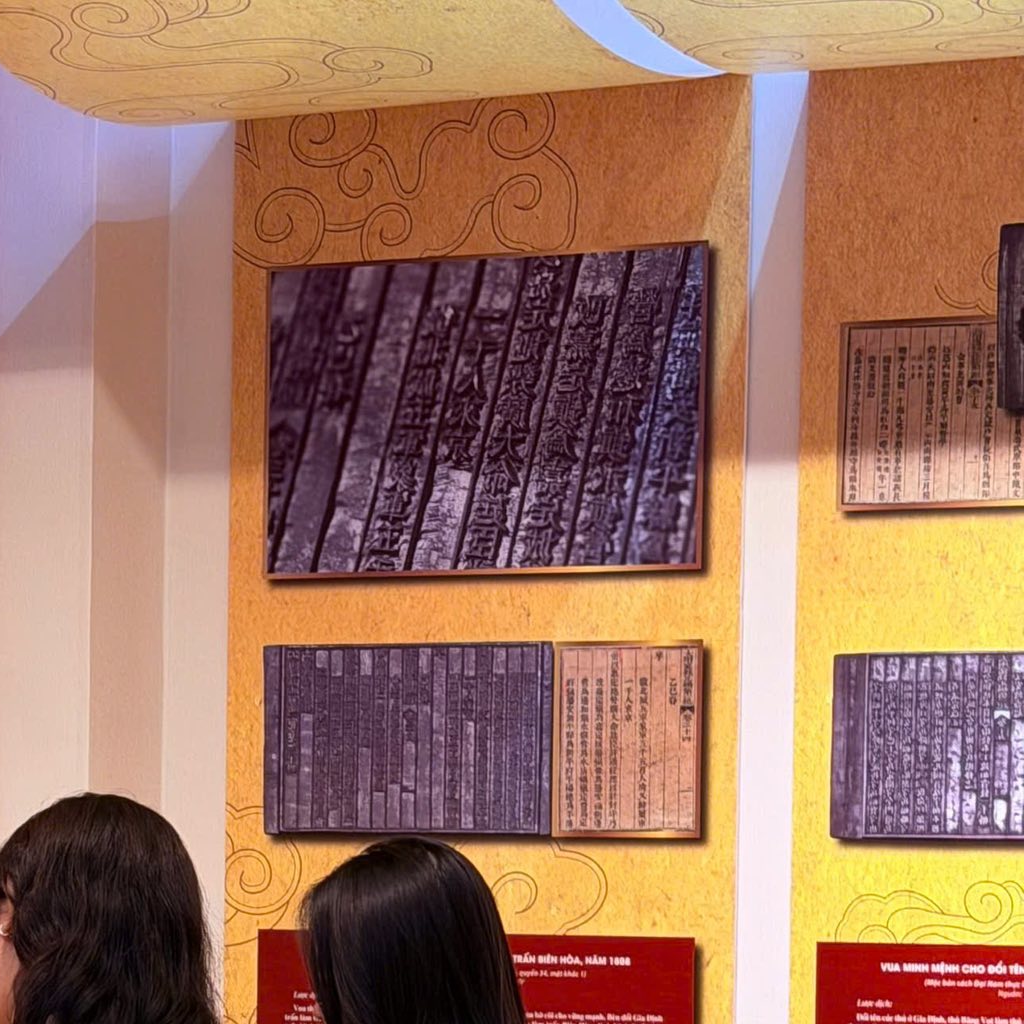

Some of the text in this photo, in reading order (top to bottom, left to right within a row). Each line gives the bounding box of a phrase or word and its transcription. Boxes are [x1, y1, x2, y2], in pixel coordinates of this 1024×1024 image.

[538, 953, 558, 964] BIÊN
[560, 954, 583, 966] HÒA,
[585, 955, 606, 965] NĂM
[880, 962, 900, 972] VUA
[902, 963, 929, 973] MINH
[931, 961, 959, 975] MỆNH
[961, 964, 985, 974] CHO
